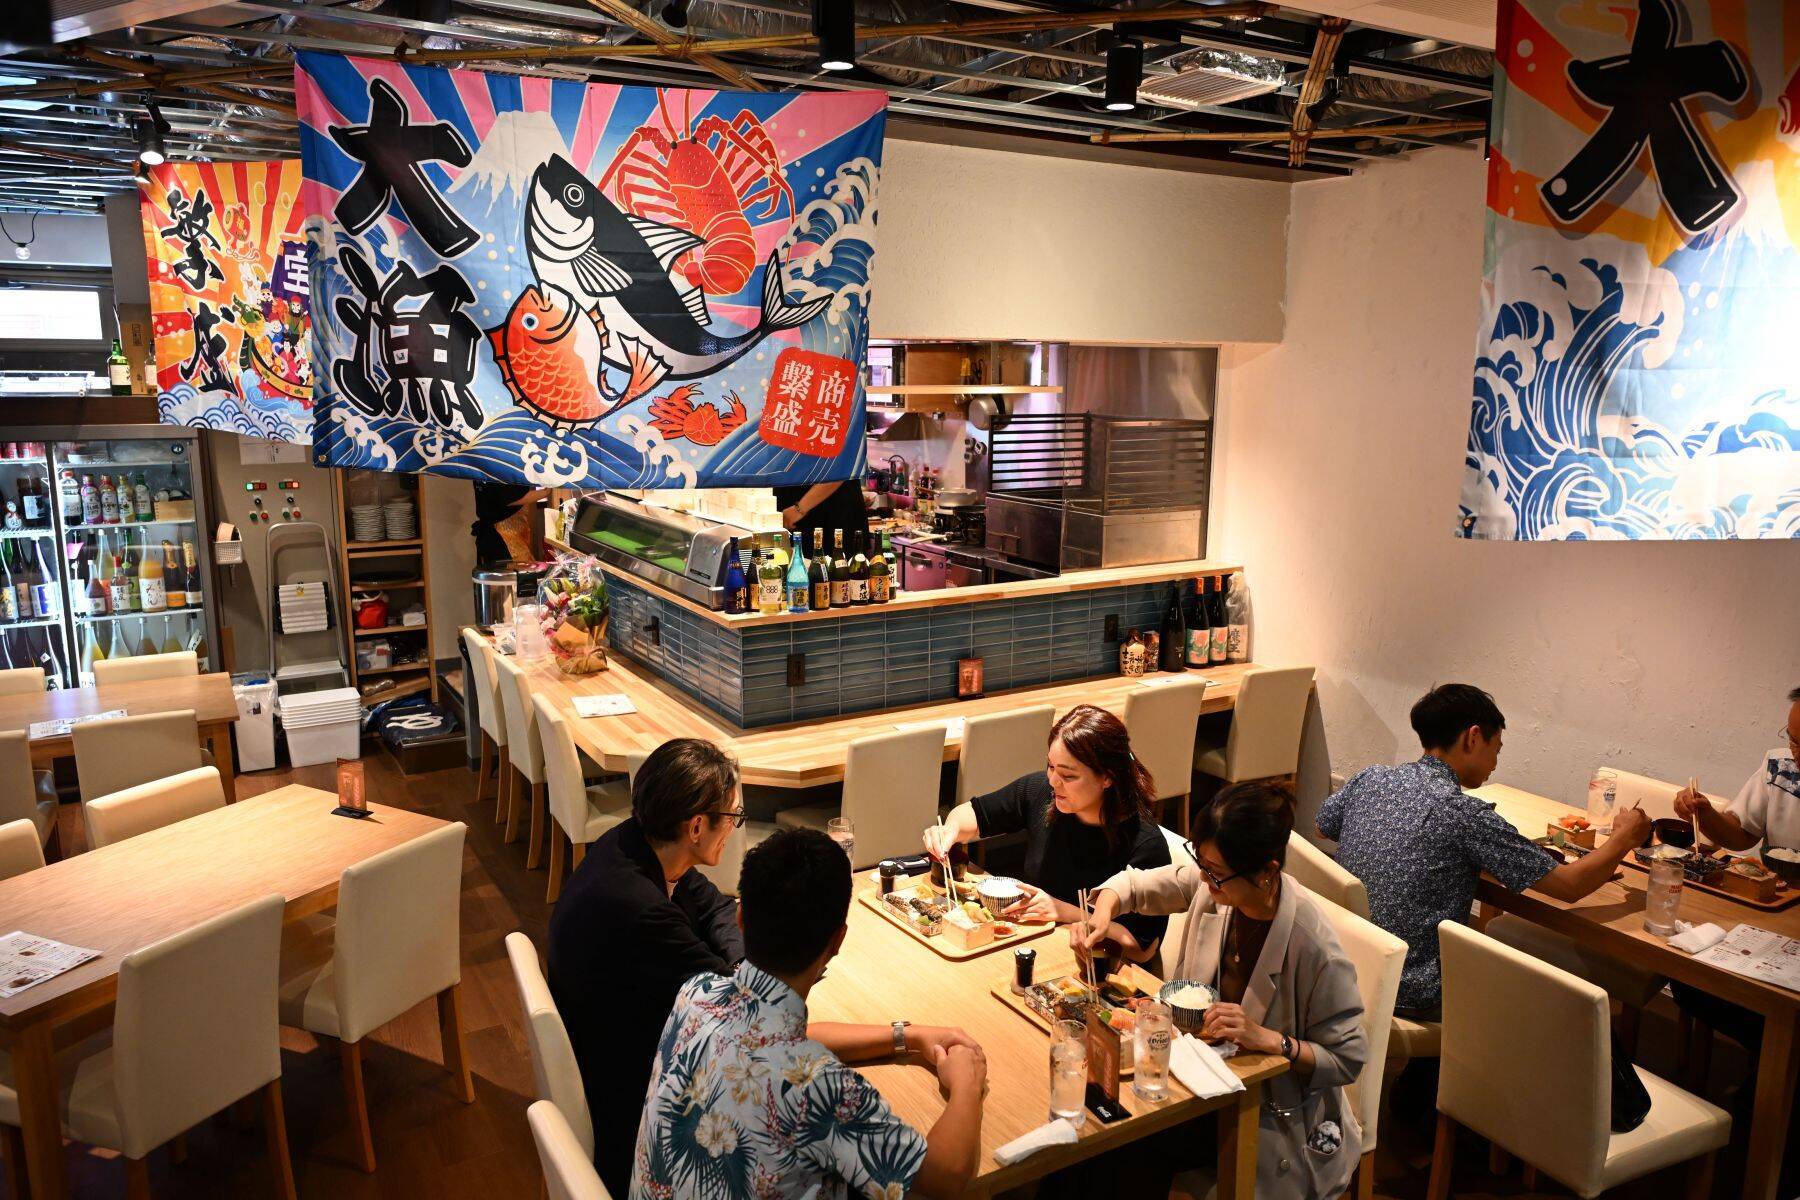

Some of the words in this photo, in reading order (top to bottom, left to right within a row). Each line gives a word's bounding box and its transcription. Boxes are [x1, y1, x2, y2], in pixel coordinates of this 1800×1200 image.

[1541, 0, 1750, 234] 大
[328, 77, 483, 431] 大漁
[806, 370, 850, 445] 商売
